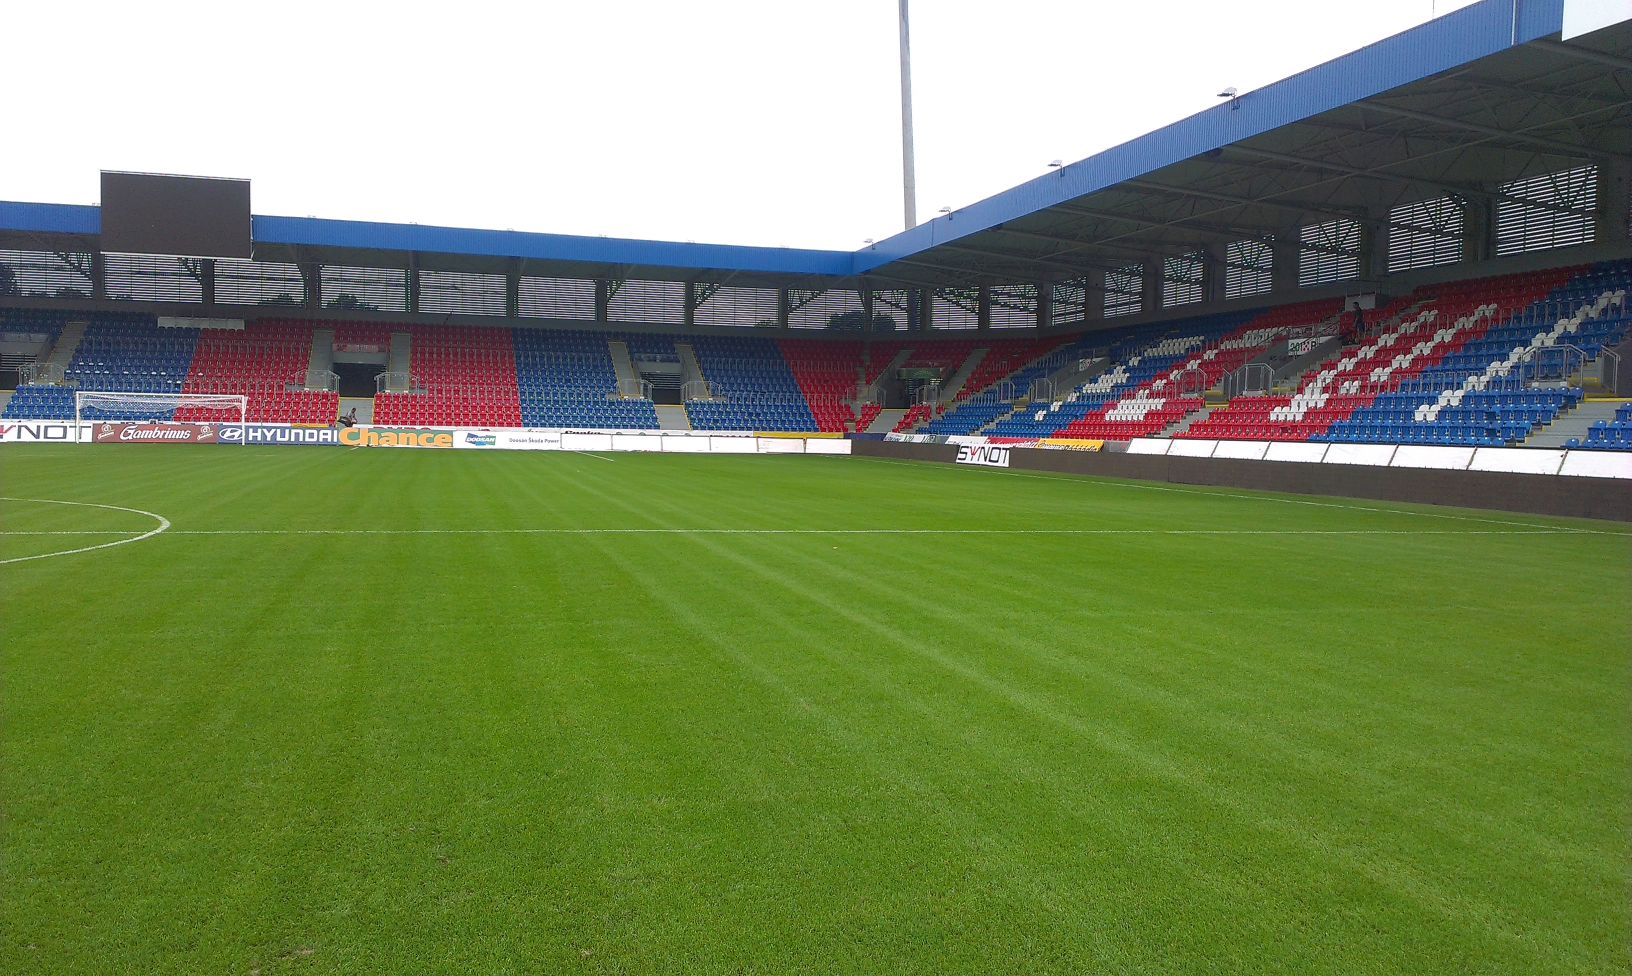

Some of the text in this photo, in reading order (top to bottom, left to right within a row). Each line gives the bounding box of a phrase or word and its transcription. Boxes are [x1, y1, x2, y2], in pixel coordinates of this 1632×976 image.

[119, 425, 191, 440] Gambrinus
[248, 428, 338, 442] HYUNDAI
[339, 427, 452, 447] Chance
[957, 445, 1010, 463] SYNOT
